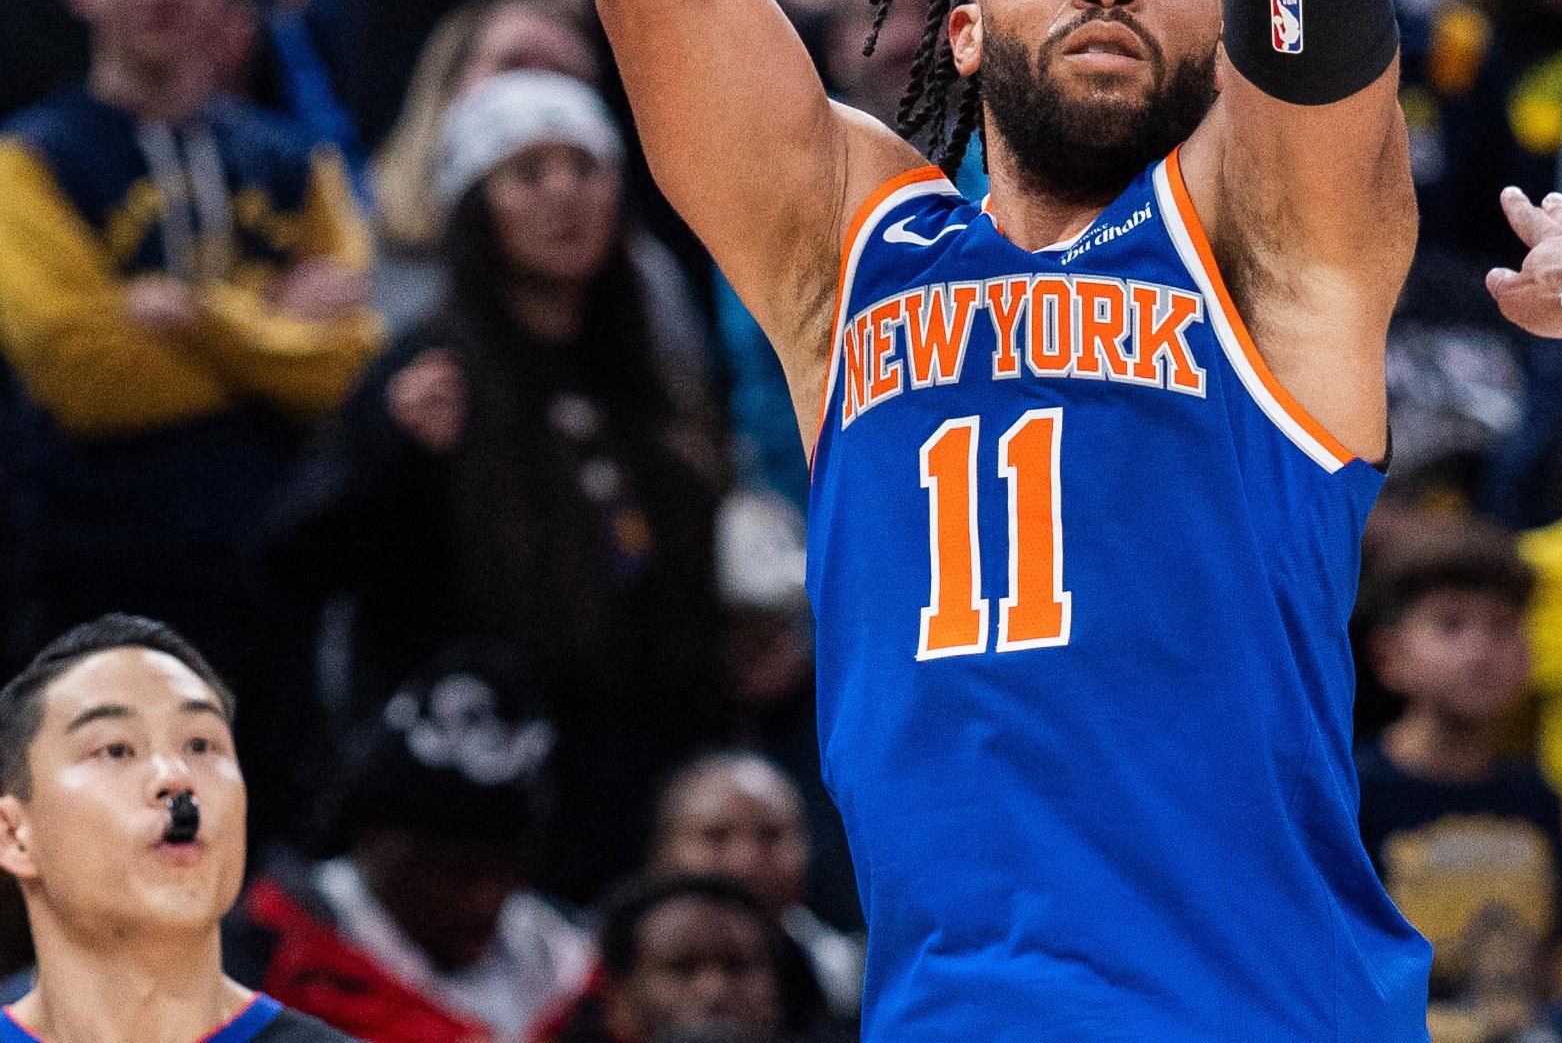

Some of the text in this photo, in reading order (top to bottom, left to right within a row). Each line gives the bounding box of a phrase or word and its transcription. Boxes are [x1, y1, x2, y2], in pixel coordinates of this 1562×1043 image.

[1094, 201, 1152, 245] dhabi
[841, 272, 1207, 431] NEW YORK
[915, 407, 1072, 662] 11
